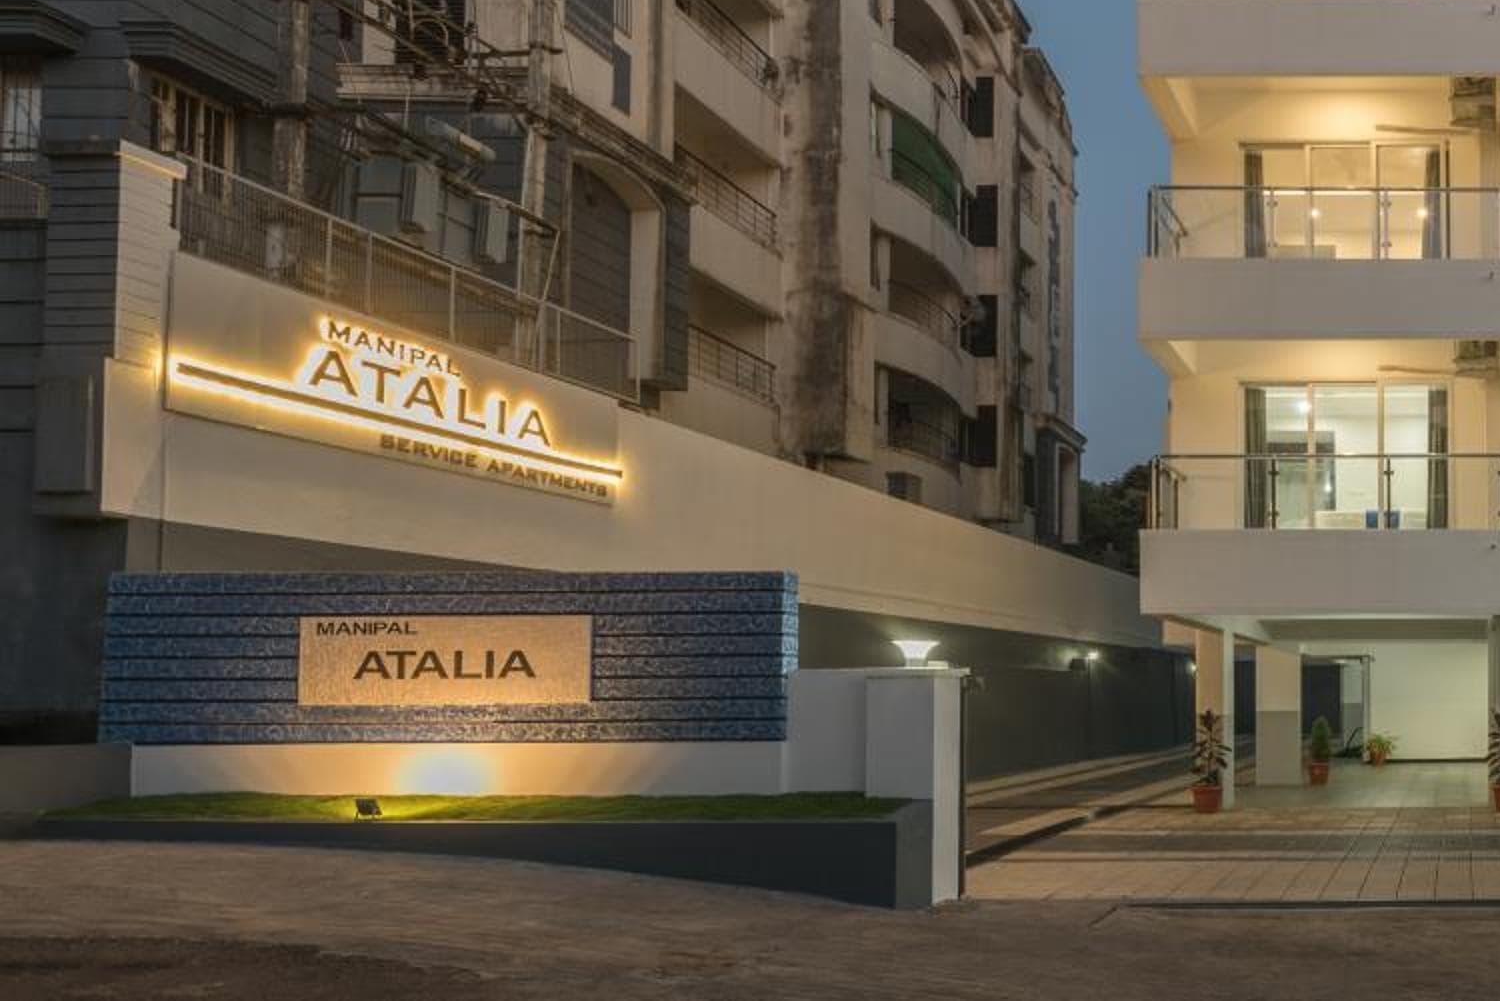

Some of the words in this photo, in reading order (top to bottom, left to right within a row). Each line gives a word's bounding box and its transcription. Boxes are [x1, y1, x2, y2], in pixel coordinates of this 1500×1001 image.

[326, 319, 461, 377] MANIPAL
[309, 350, 550, 447] ATALIA
[379, 433, 477, 469] SERVICE
[486, 459, 608, 497] APARTMENTS
[316, 622, 418, 636] MANIPAL
[353, 650, 536, 679] ATALIA
